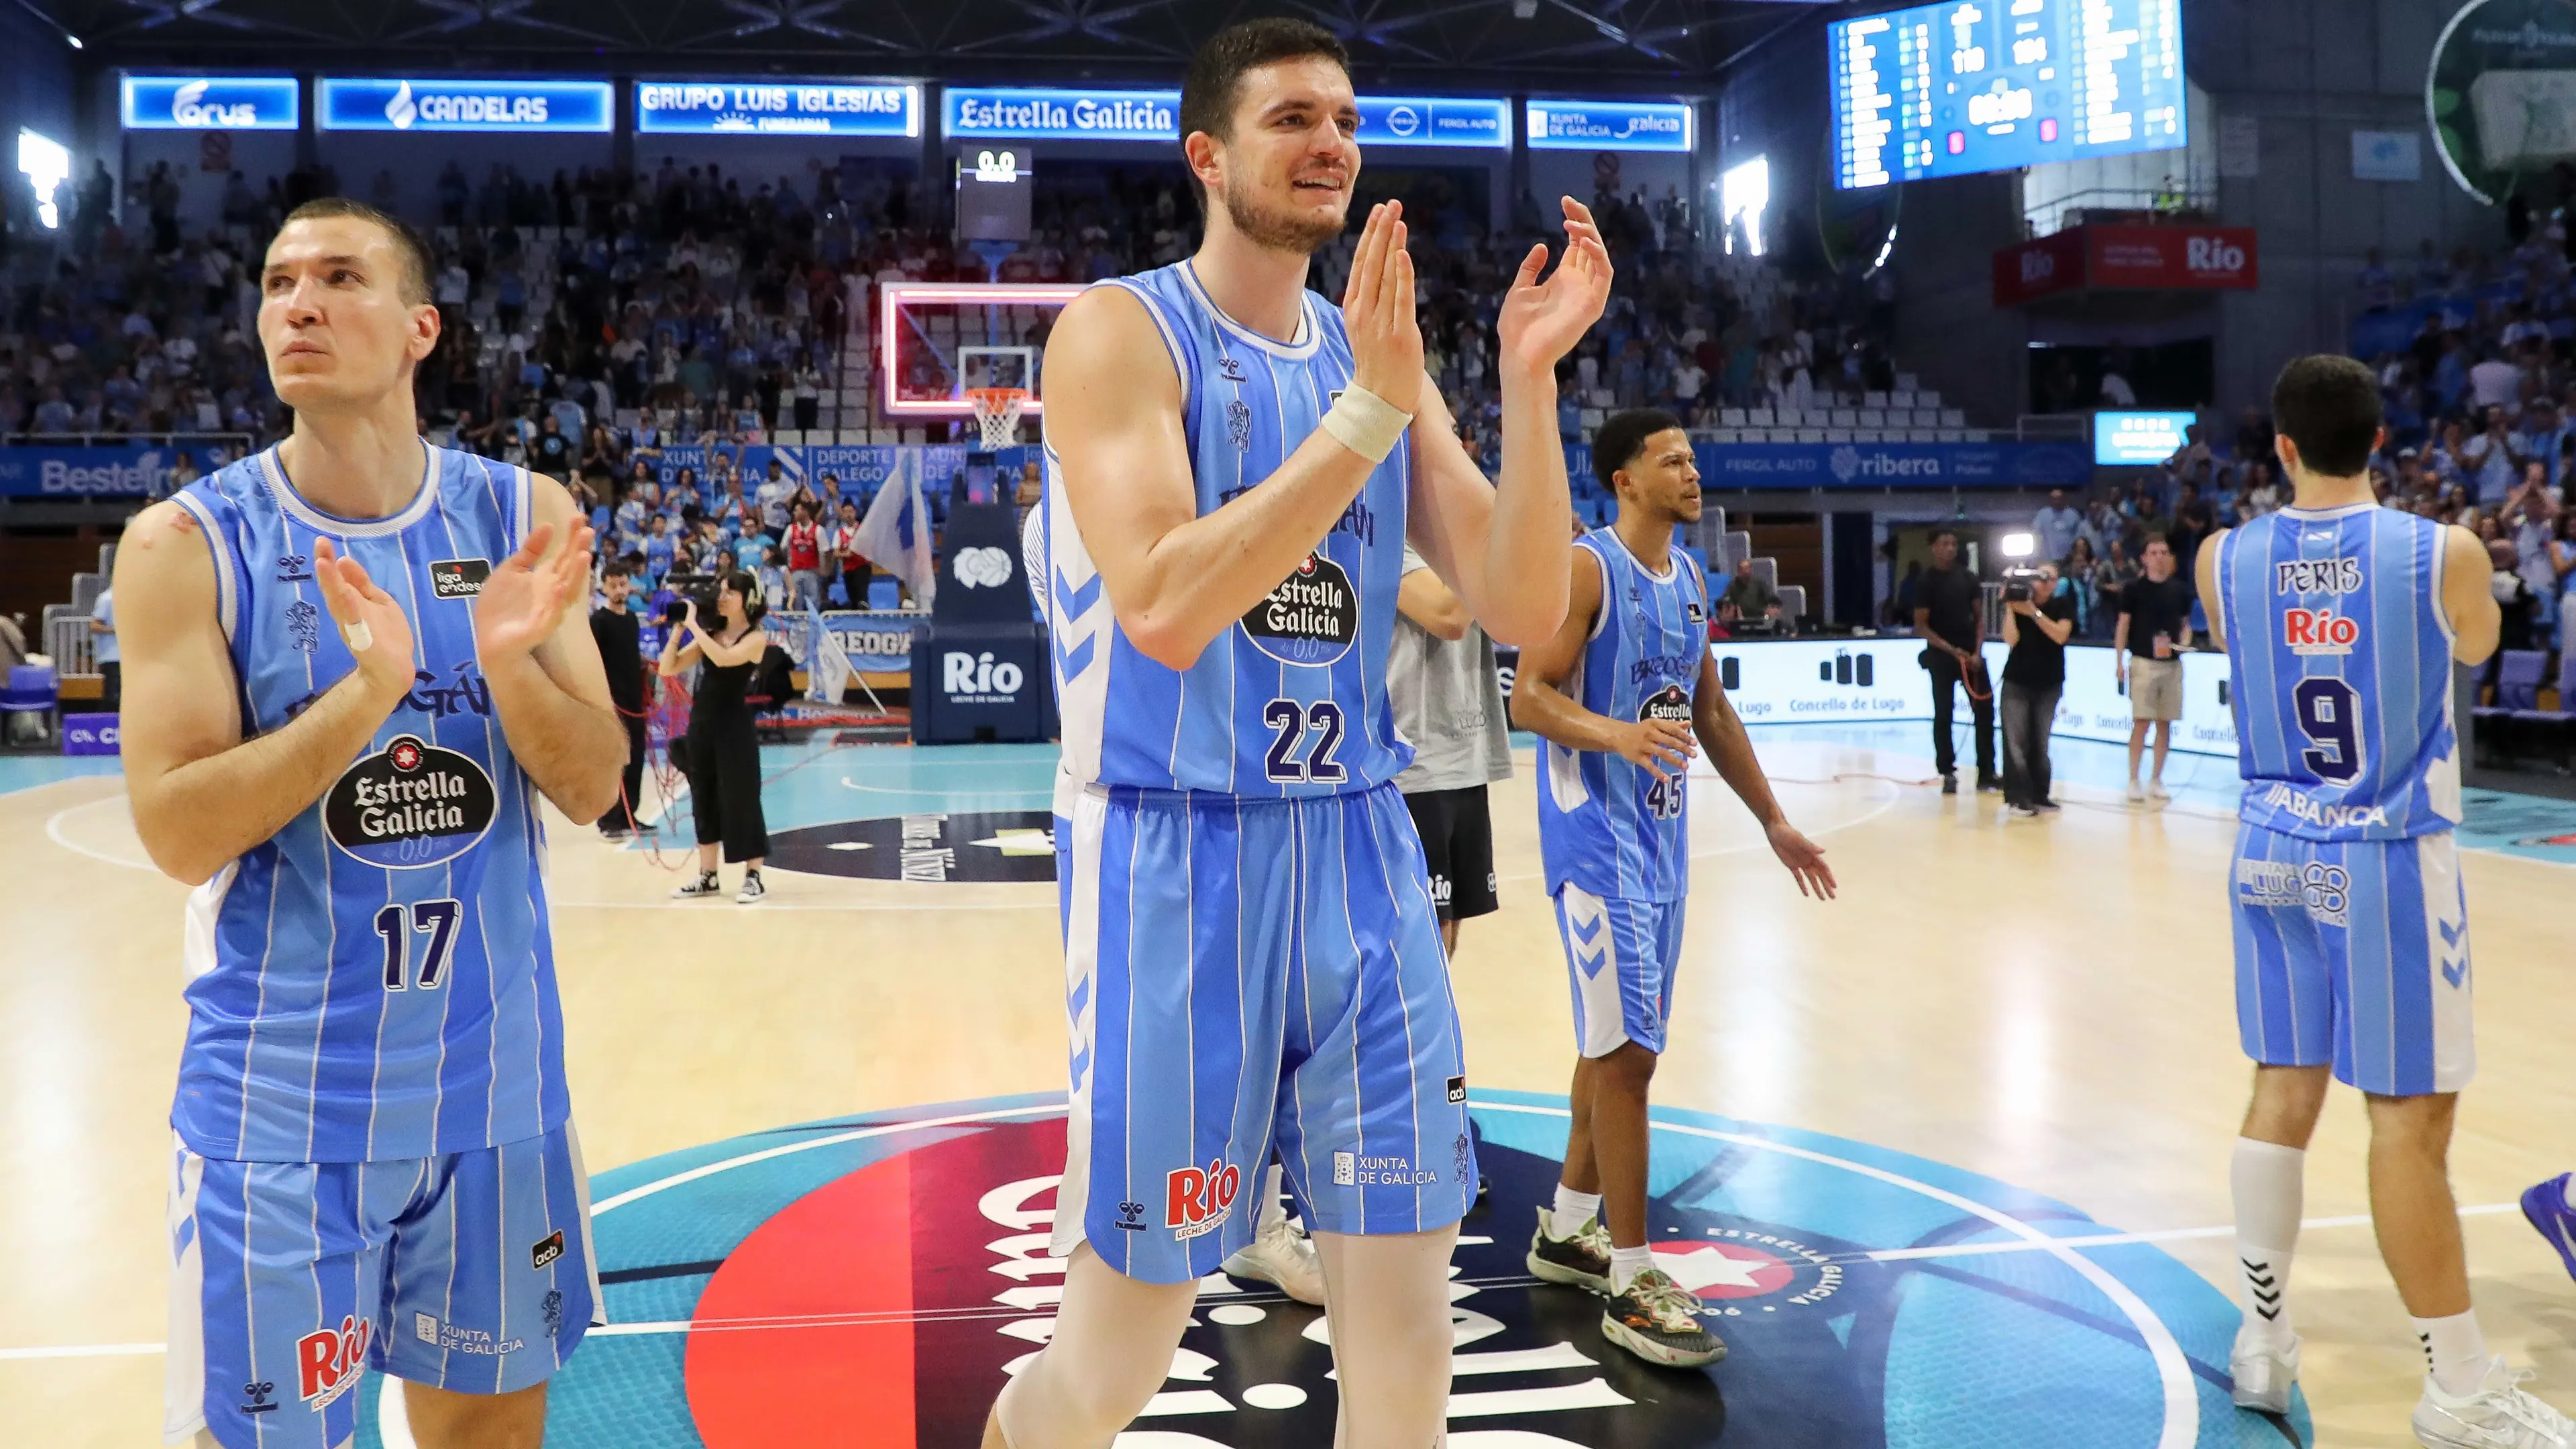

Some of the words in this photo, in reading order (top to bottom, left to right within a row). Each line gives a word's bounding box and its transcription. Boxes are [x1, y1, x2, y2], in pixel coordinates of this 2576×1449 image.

[419, 95, 548, 123] CANDELAS
[640, 87, 725, 111] GRUPO
[734, 88, 788, 112] LUIS
[797, 88, 901, 113] IGLESIAS
[959, 99, 1069, 129] Estrella
[1073, 99, 1173, 131] Galicia
[817, 449, 891, 464] DEPORTE
[1861, 452, 1941, 476] ribera
[436, 572, 462, 584] liga
[2277, 557, 2362, 595] PERIS
[1267, 602, 1340, 637] Galicia
[2286, 609, 2358, 645] Río
[943, 651, 1023, 694] Río
[1650, 702, 1691, 719] Estrella
[1738, 702, 1772, 715] Lugo
[1790, 698, 1843, 712] Concello
[1850, 698, 1867, 710] de
[1872, 698, 1905, 712] Lugo
[1263, 698, 1348, 784] 22
[2292, 676, 2365, 787] 9
[355, 771, 468, 809] Estrella
[1646, 771, 1686, 820] 45
[360, 800, 465, 837] Galicia
[374, 897, 464, 992] 17
[1449, 1085, 1465, 1101] acb
[1358, 1156, 1409, 1171] XUNTA
[1358, 1171, 1379, 1185] DE
[1381, 1170, 1438, 1185] GALICIA
[1165, 1158, 1240, 1228] Río
[1177, 1226, 1203, 1238] LECHE
[1204, 1221, 1213, 1231] DE
[535, 1244, 559, 1266] acb
[441, 1322, 491, 1342] XUNTA
[297, 1316, 370, 1400] Río
[441, 1338, 459, 1350] DE
[462, 1338, 525, 1356] GALICIA
